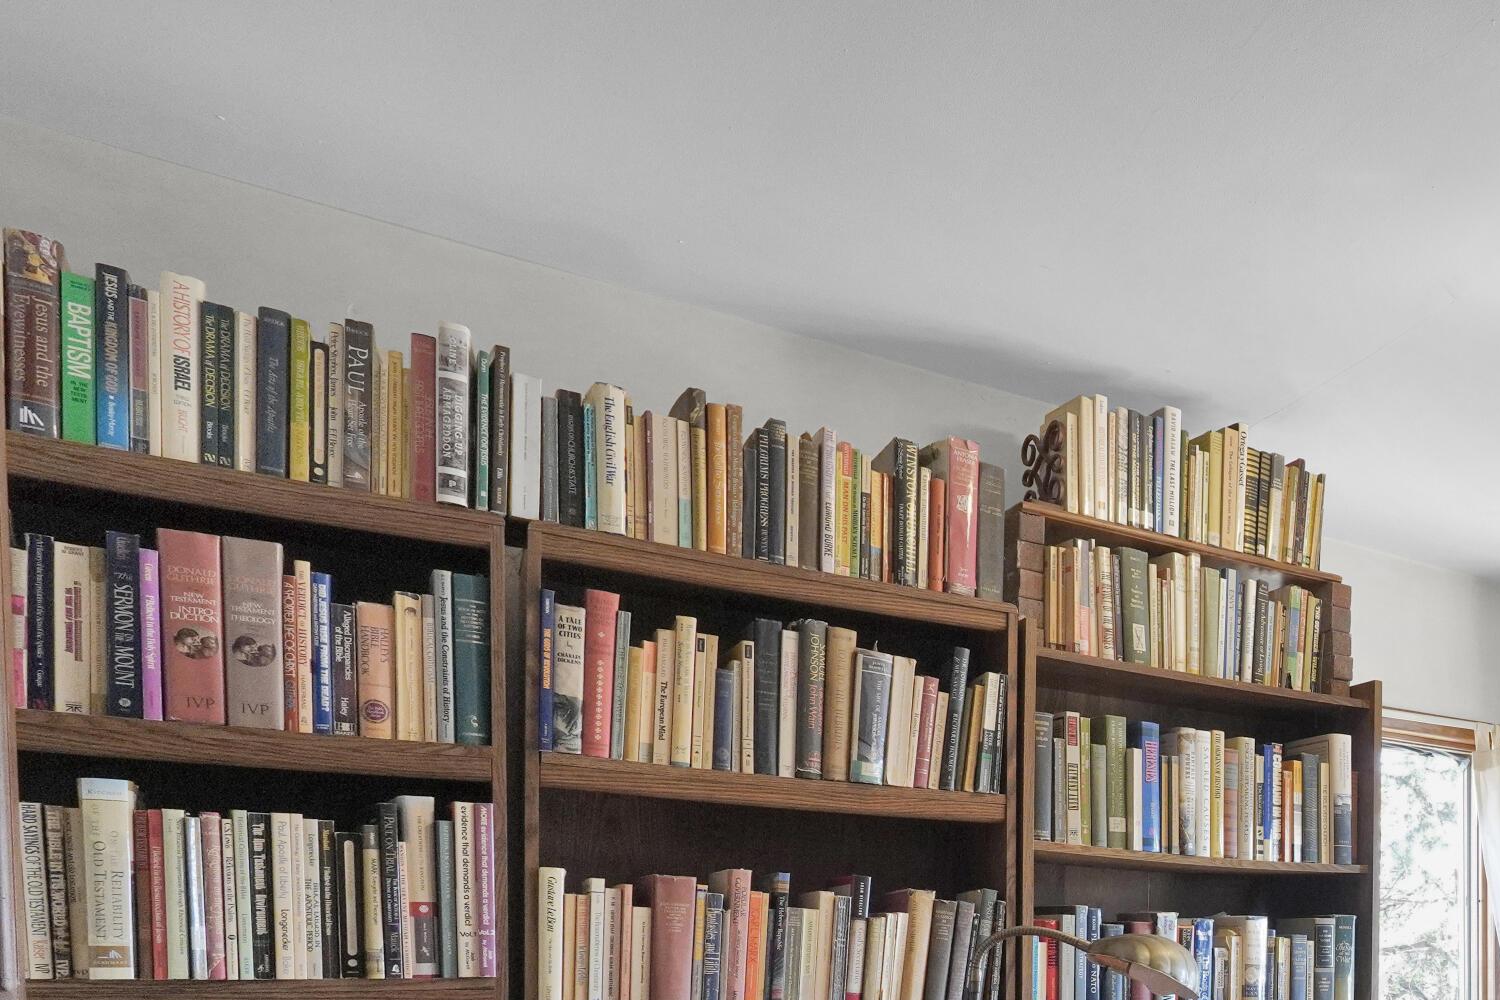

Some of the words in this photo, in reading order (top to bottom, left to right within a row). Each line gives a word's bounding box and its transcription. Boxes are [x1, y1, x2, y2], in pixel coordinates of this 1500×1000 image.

[104, 273, 118, 298] JESUS
[172, 280, 189, 290] A
[34, 296, 52, 333] Jesus
[173, 293, 190, 337] HISTORY
[205, 315, 214, 325] The
[36, 336, 51, 360] and
[67, 302, 91, 380] BAPTISM
[105, 321, 118, 360] KINGDOM
[173, 338, 191, 354] OF
[205, 327, 215, 358] DRAMA
[36, 365, 51, 387] the
[105, 363, 118, 374] OF
[173, 355, 191, 390] ISRAEL
[348, 345, 368, 394] PAUL
[106, 375, 118, 393] GOD
[205, 368, 215, 407] DECISION
[358, 401, 367, 425] Apostle
[455, 395, 463, 438] DIGGING
[605, 397, 614, 412] The
[442, 387, 451, 458] ARMAGEDDON
[604, 414, 616, 446] English
[358, 436, 367, 448] the
[455, 443, 462, 456] UP
[480, 449, 488, 466] JESUS
[605, 448, 616, 470] Civil
[760, 434, 768, 479] PILGRIMS
[606, 470, 615, 486] War
[906, 443, 916, 498] WINSTON
[760, 483, 768, 527] PROGRESS
[905, 504, 916, 574] CHURCHILL
[168, 566, 216, 577] DONALD
[114, 583, 134, 632] SERMON
[171, 596, 216, 605] TESTAMENT
[284, 589, 294, 622] SHORTER
[319, 598, 327, 623] JESUS
[170, 612, 219, 624] DUCTION
[231, 614, 277, 624] THEOLOGY
[343, 610, 352, 636] Alleged
[284, 624, 294, 638] LIFE
[371, 627, 379, 648] BIBLE
[284, 639, 294, 651] OF
[361, 625, 369, 675] HANDBOOK
[809, 632, 819, 682] JOHNSON
[115, 646, 134, 688] MOUNT
[284, 653, 295, 678] CHRIST
[344, 637, 352, 680] Discrepancies
[185, 697, 216, 709] IVP
[321, 687, 329, 712] DEAD?
[340, 697, 349, 716] Haley
[808, 684, 818, 705] John
[241, 703, 269, 715] IVP
[442, 697, 451, 722] History
[659, 695, 667, 723] European
[808, 707, 817, 729] Wain
[950, 713, 958, 743] RICHARD
[948, 746, 956, 771] HOLMES
[1145, 741, 1158, 783] HERESIES
[22, 803, 36, 824] HARD
[384, 815, 395, 834] PAUL
[461, 806, 469, 840] evidence
[23, 825, 40, 854] SAYINGS
[385, 836, 394, 850] ON
[462, 842, 470, 856] that
[26, 856, 41, 865] OF
[93, 840, 106, 867] OLD
[385, 851, 396, 873] TRIAL
[27, 865, 43, 880] THE
[28, 881, 44, 896] OLD
[94, 869, 107, 940] TESTAMENT
[111, 870, 124, 940] RELIABILITY
[464, 902, 472, 926] verdict
[732, 877, 741, 926] GOVERNMENT
[30, 898, 46, 936] TESTAMENT
[777, 907, 785, 926] Hebrew
[280, 909, 289, 951] Longenecker
